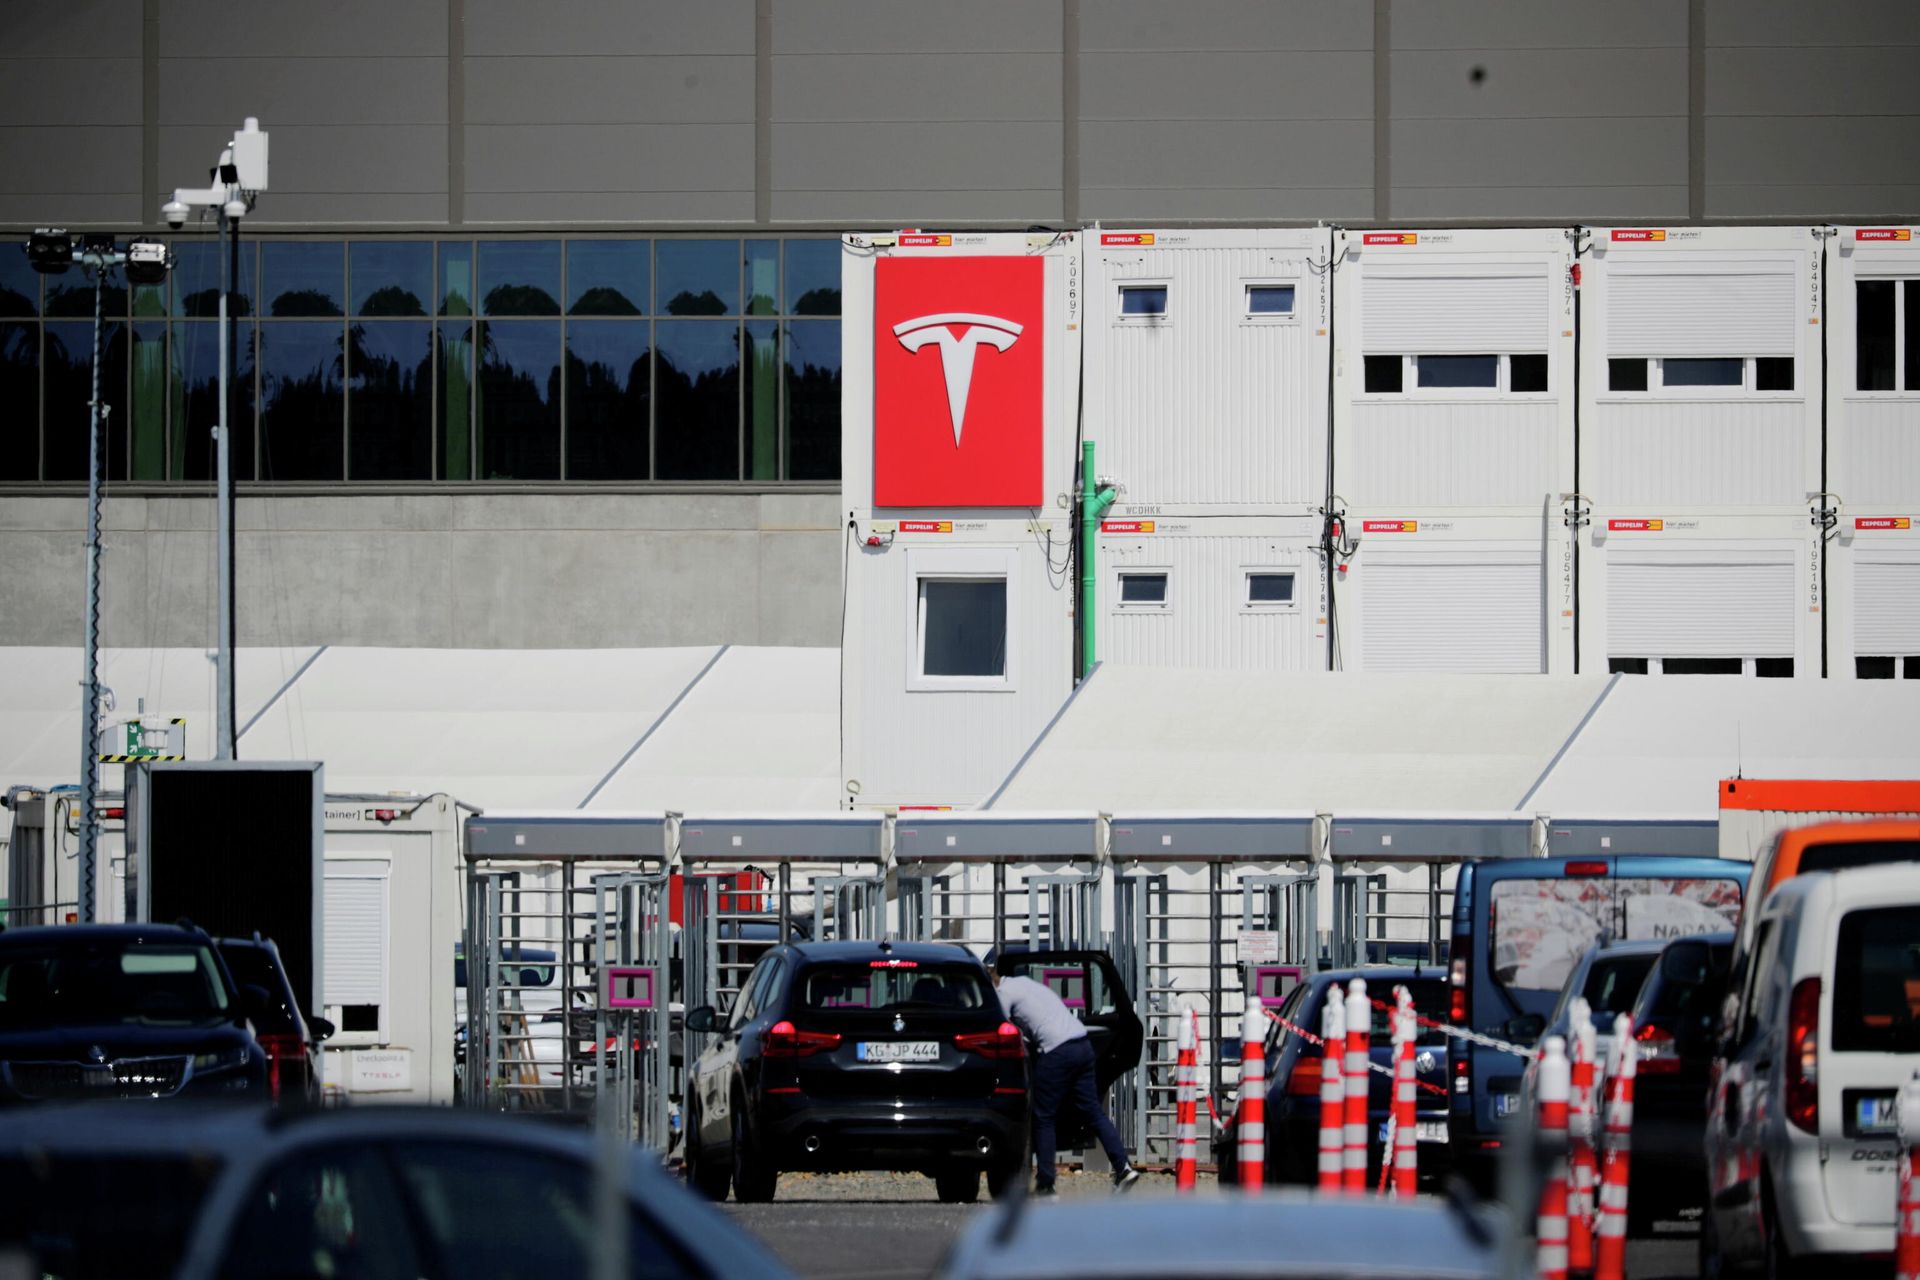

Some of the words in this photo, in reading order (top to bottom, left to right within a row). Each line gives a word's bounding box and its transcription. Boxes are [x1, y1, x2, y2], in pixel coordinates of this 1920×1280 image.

[1069, 256, 1077, 319] 206697
[1563, 541, 1571, 604] 195477
[866, 1045, 884, 1057] KG
[892, 1045, 910, 1057] JP
[912, 1044, 937, 1057] 444
